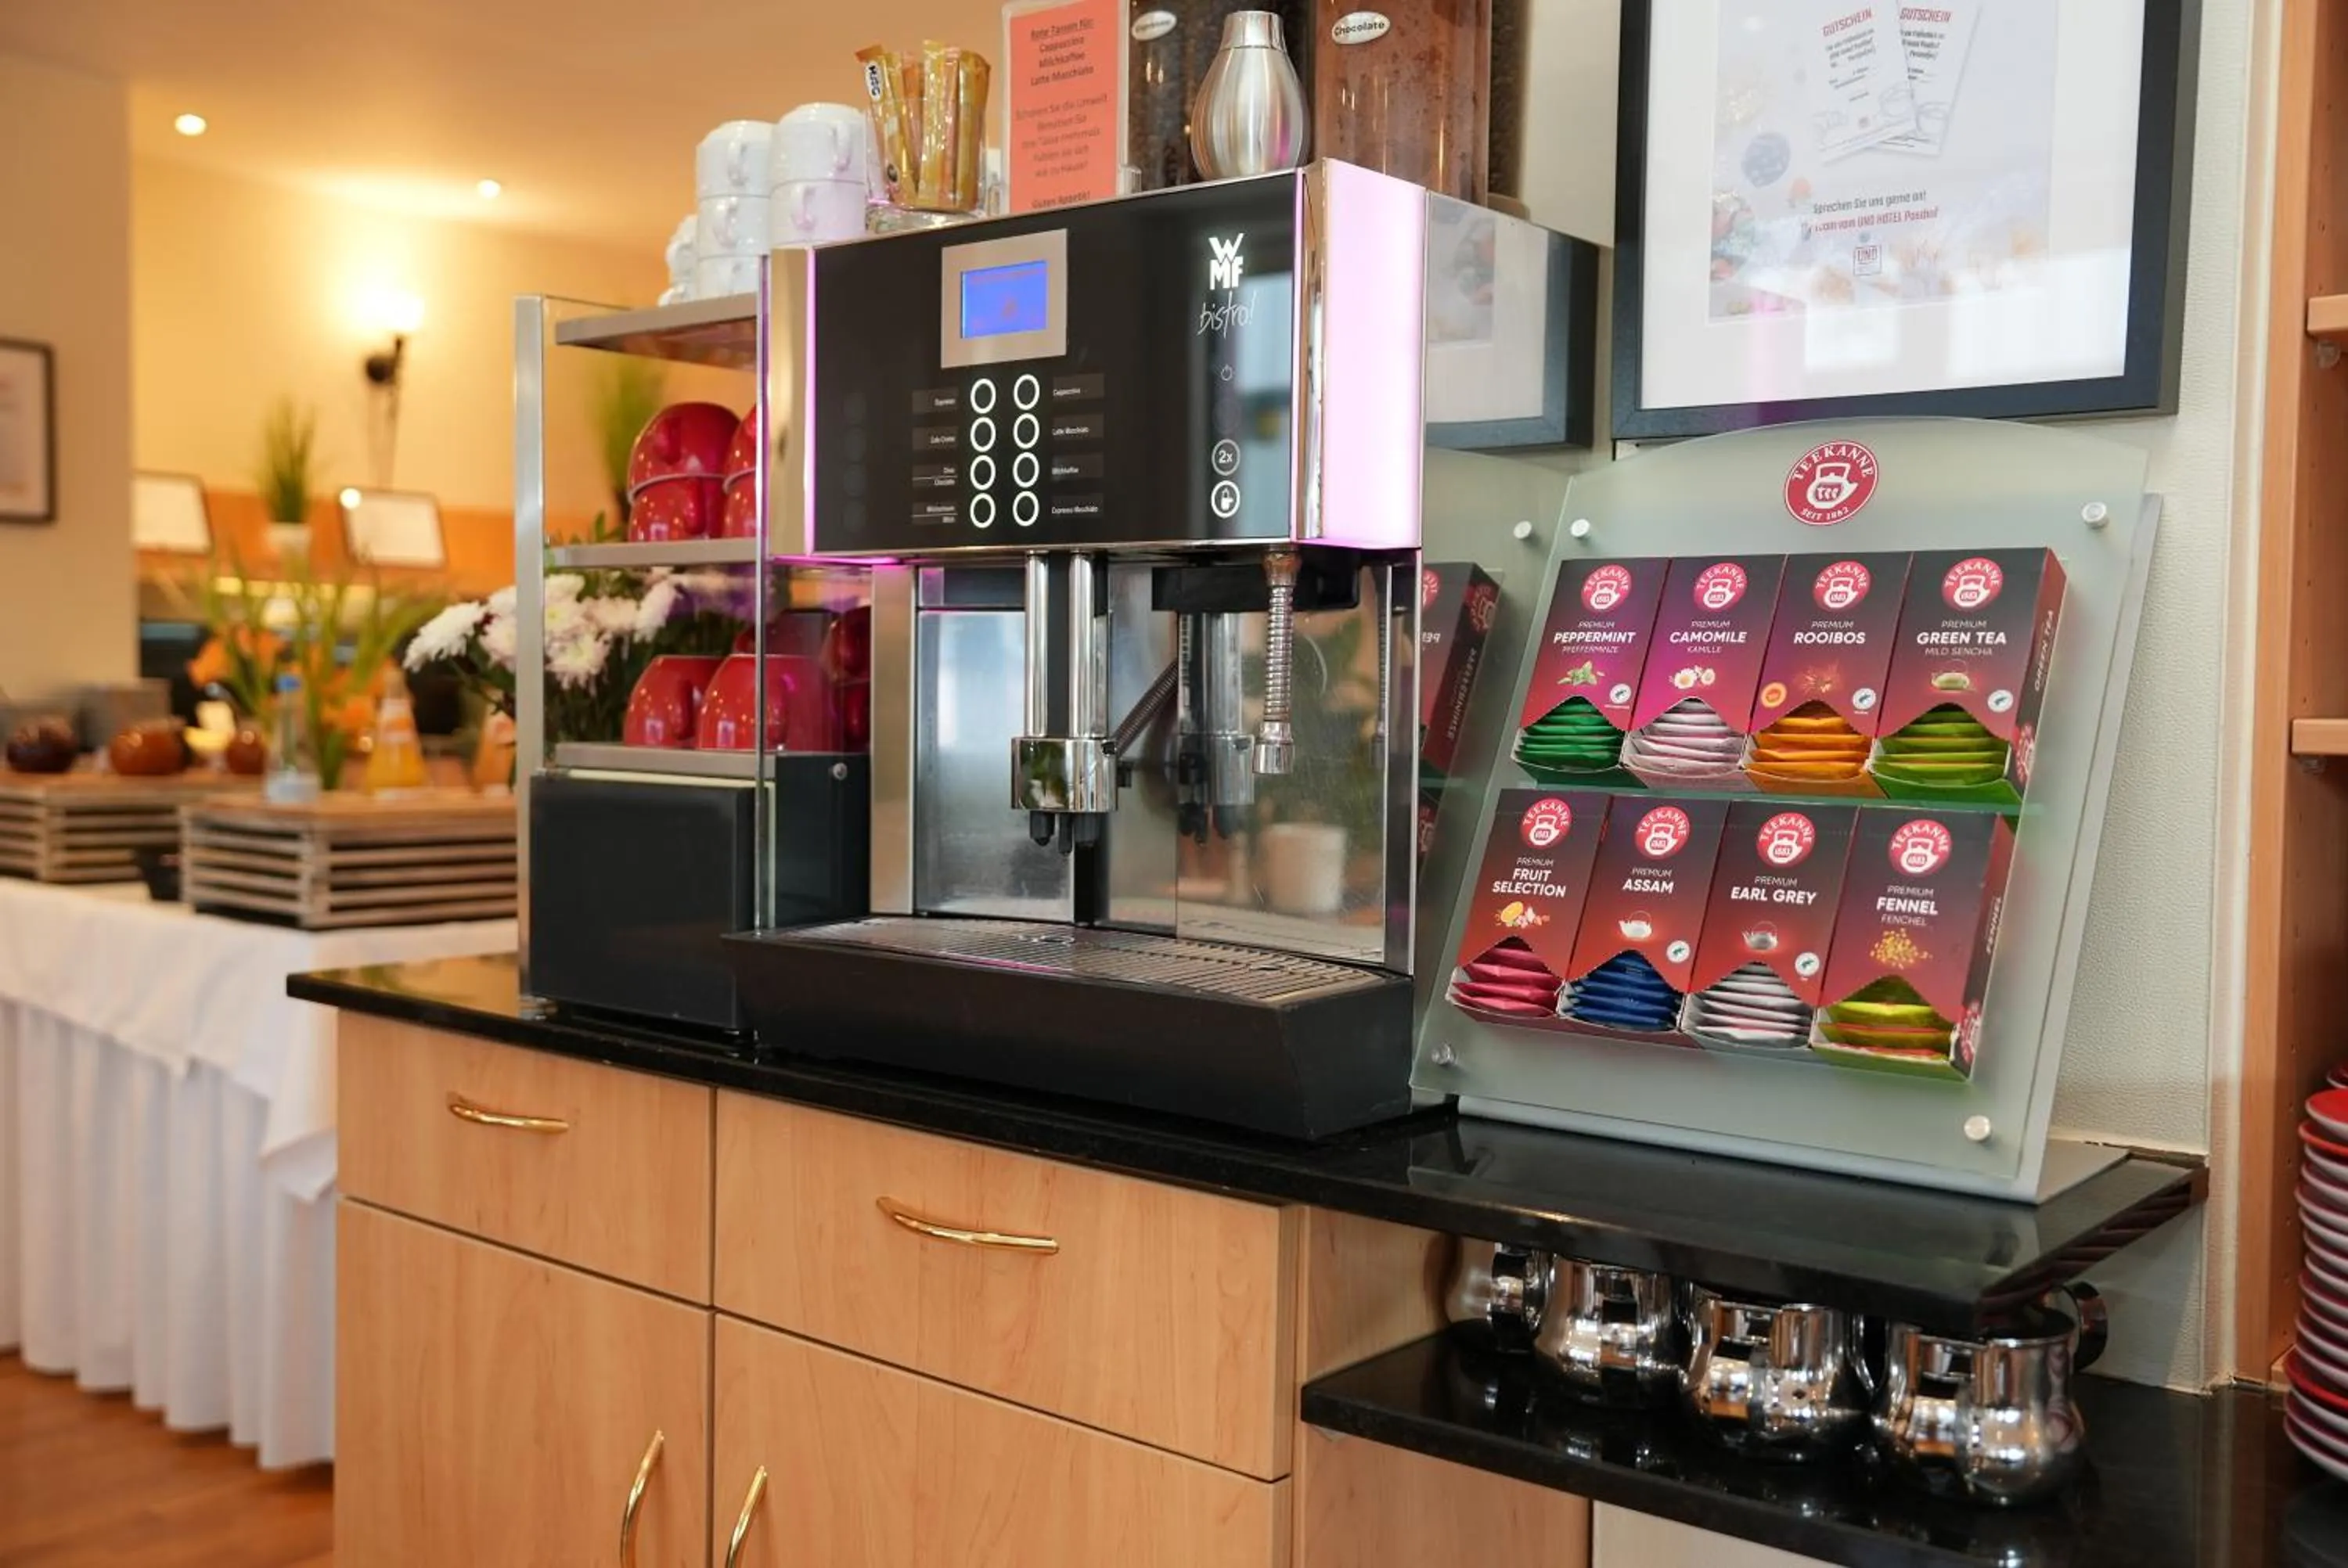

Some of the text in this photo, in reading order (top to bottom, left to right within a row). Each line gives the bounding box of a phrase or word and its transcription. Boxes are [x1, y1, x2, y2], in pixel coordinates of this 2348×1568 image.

[1823, 7, 1872, 37] GUTSCHEIN
[1900, 8, 1952, 23] GUTSCHEIN
[1334, 20, 1385, 37] Chocolate
[1853, 196, 1867, 209] Sie
[1869, 194, 1884, 207] uns
[1208, 233, 1244, 290] WMF
[1197, 290, 1257, 339] bistro!
[1219, 450, 1233, 463] 2x
[1792, 445, 1874, 479] TEEKANNE
[1802, 508, 1822, 520] SEIT
[1584, 564, 1629, 592] TEEKANNE
[1696, 566, 1745, 589] TEEKANNE
[1816, 564, 1867, 590] TEEKANNE
[1945, 561, 2000, 588] TEEKANNE
[1811, 620, 1854, 629] PREMIUM
[1942, 620, 1987, 628] PREMIUM
[1554, 631, 1636, 644] PEPPERMINT
[1669, 631, 1748, 644] CAMOMILE
[1794, 631, 1866, 645] ROOIBOS
[1917, 631, 2007, 645] GREEN TEA
[1562, 646, 1619, 654] PFEFFERMINZE
[1687, 646, 1722, 654] KAMILLE
[1925, 646, 1993, 656] MILD SENCHA
[1523, 801, 1569, 826] TEEKANNE
[1638, 810, 1687, 836] TEEKANNE
[1760, 815, 1812, 843] TEEKANNE
[1891, 823, 1949, 853] TEEKANNE
[1516, 857, 1554, 867] PREMIUM
[1513, 868, 1552, 882] FRUIT
[1632, 867, 1672, 877] PREMIUM
[1622, 879, 1674, 894] ASSAM
[1754, 876, 1798, 886] PREMIUM
[1493, 881, 1566, 897] SELECTION
[1730, 886, 1817, 905] EARL GREY
[1887, 885, 1934, 897] PREMIUM
[1877, 897, 1939, 915] FENNEL
[1881, 914, 1927, 926] FENCHEL
